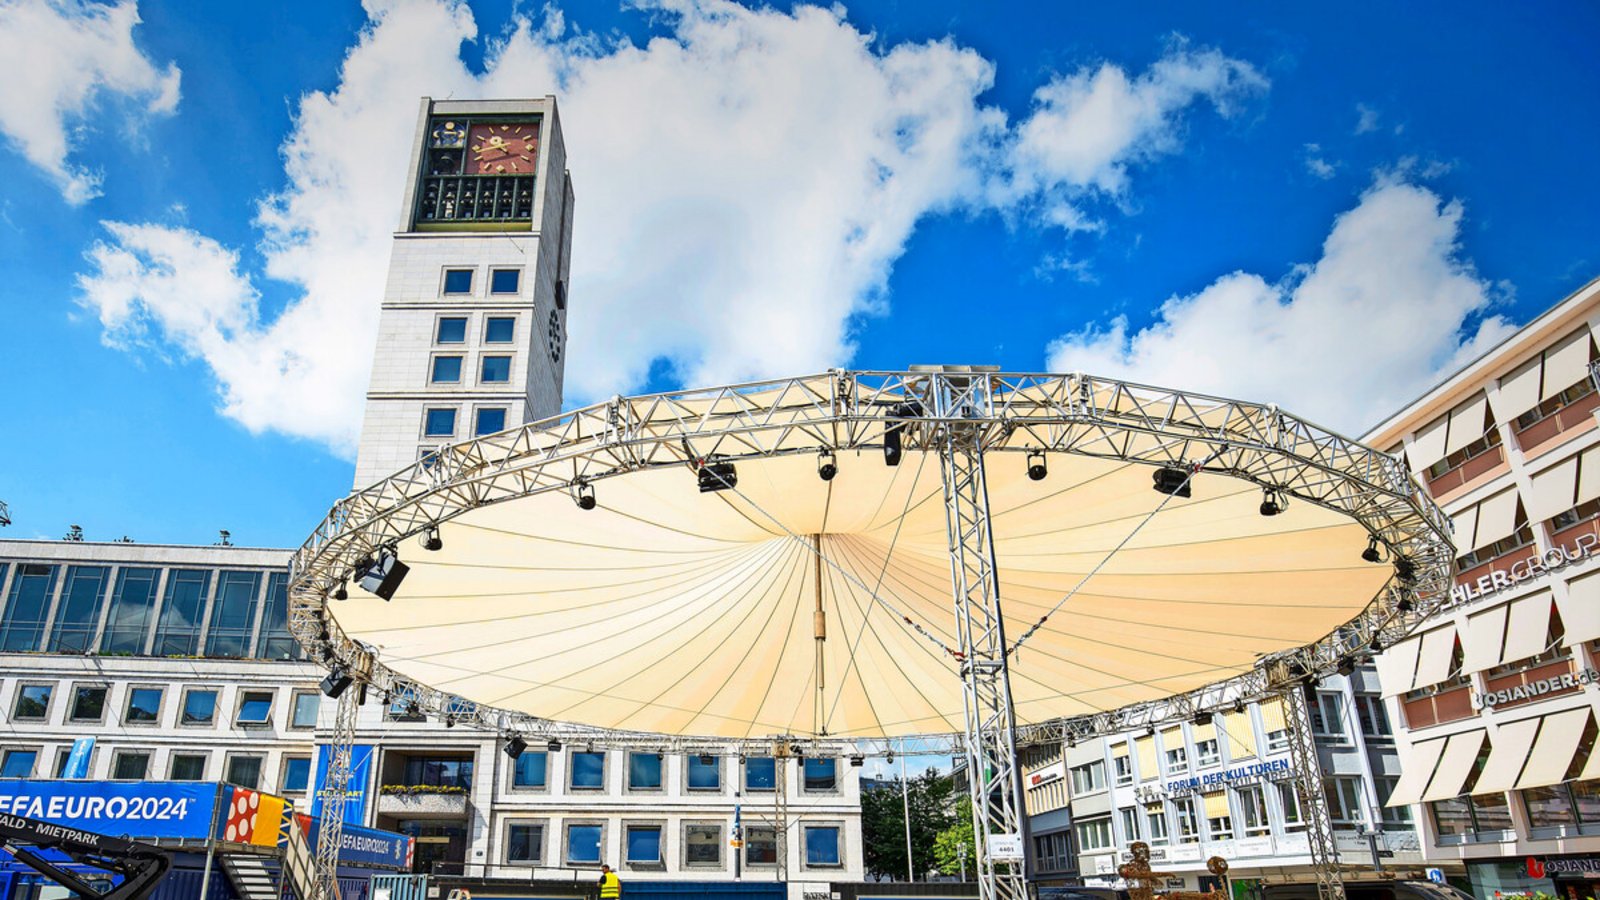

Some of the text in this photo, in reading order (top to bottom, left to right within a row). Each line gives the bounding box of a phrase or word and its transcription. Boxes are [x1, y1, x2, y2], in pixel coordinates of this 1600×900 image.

[1167, 758, 1289, 792] FORUM DER KULTUREN
[0, 814, 26, 829] ALD
[35, 822, 100, 845] MIETPARK
